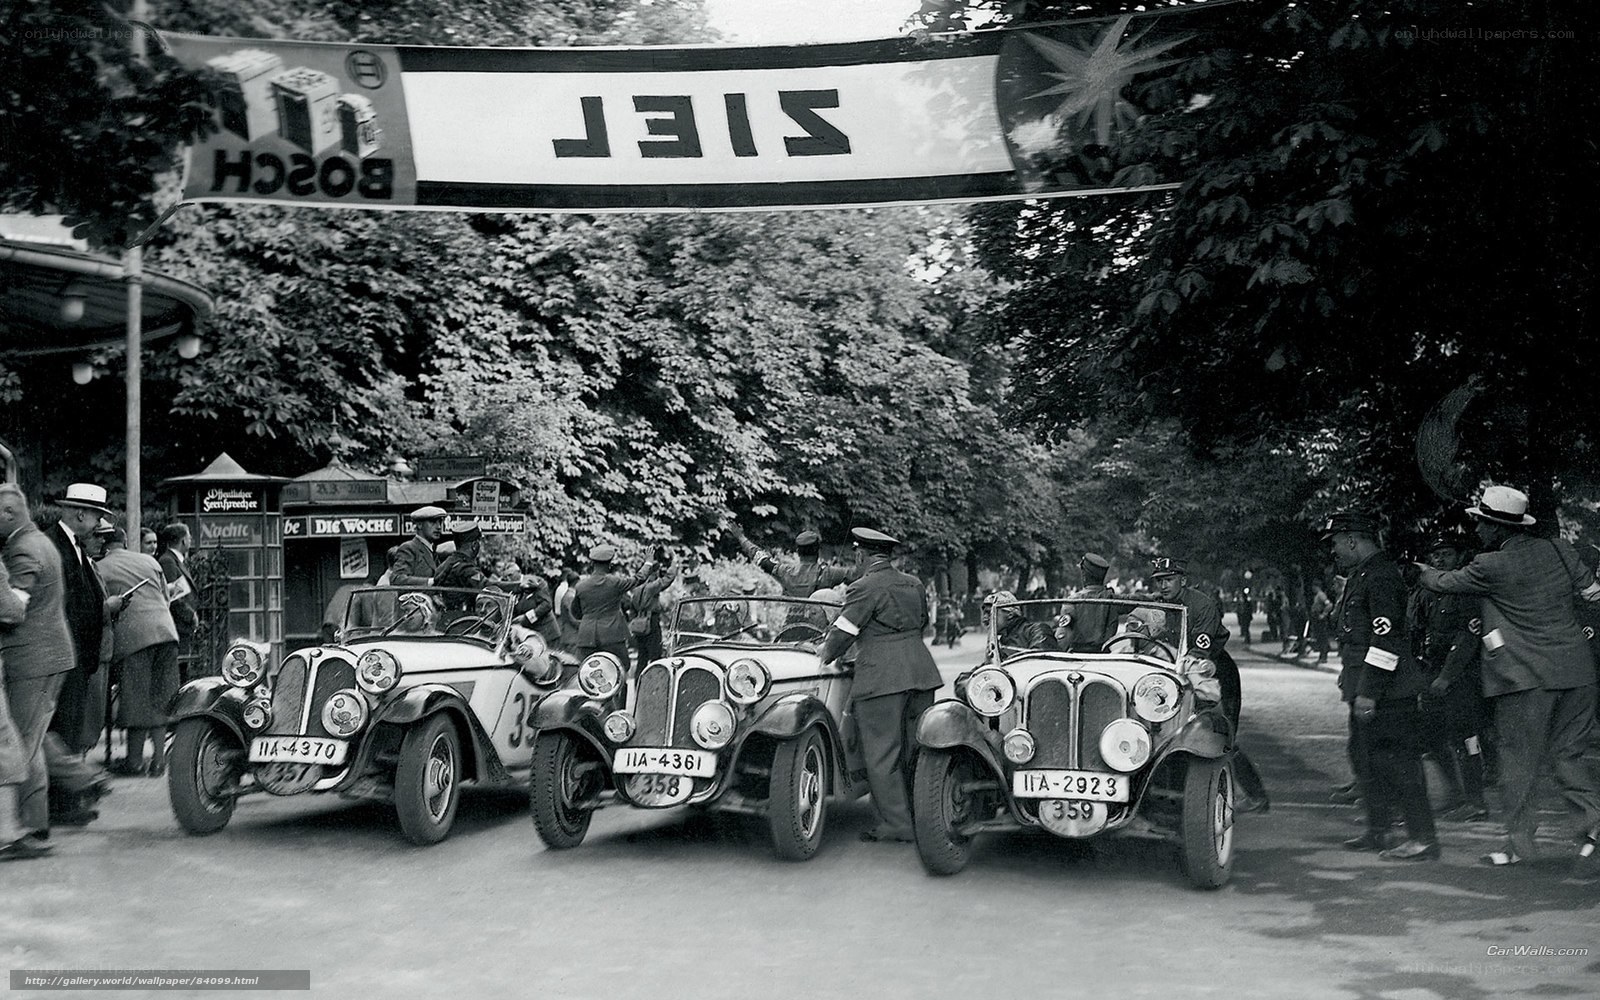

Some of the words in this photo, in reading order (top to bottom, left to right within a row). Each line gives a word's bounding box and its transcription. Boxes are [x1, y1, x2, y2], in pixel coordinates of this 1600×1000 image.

[315, 519, 341, 534] DIE
[341, 518, 394, 533] WOCHE
[626, 752, 702, 771] IIA-4361
[641, 774, 680, 798] 358
[1024, 774, 1117, 797] IIA-2923
[1052, 799, 1095, 821] 359
